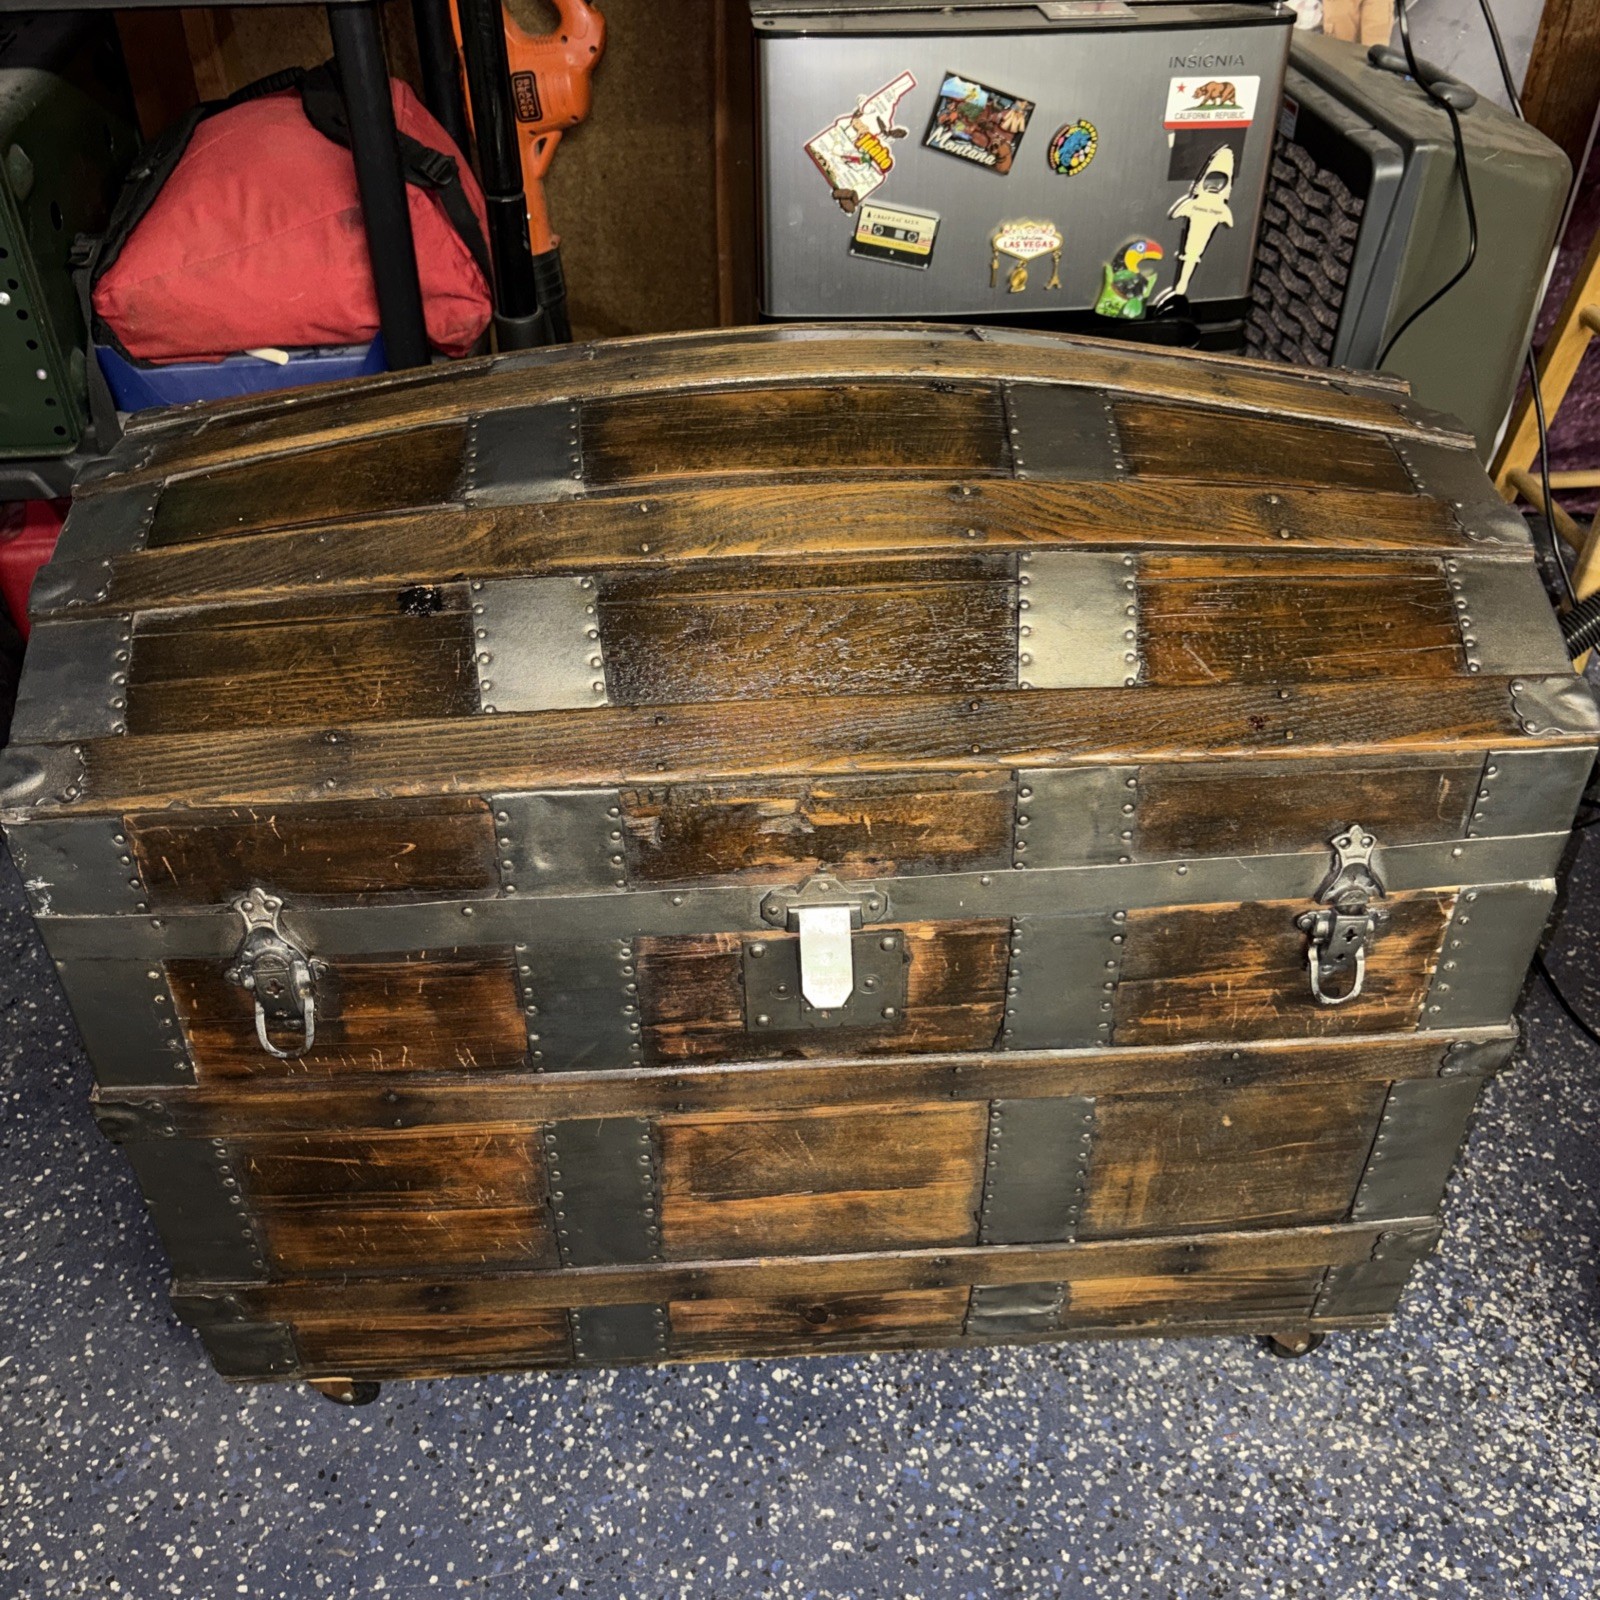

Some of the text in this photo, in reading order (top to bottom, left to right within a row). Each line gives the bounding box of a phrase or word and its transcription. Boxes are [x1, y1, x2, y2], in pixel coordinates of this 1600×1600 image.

[1168, 54, 1245, 68] INSIGNIA
[515, 79, 529, 117] DECKER
[1174, 111, 1245, 120] CALIFORNIA REPUBLIC
[855, 132, 893, 171] Idaho
[926, 126, 996, 165] Montana
[1003, 240, 1054, 248] LAS VEGAS
